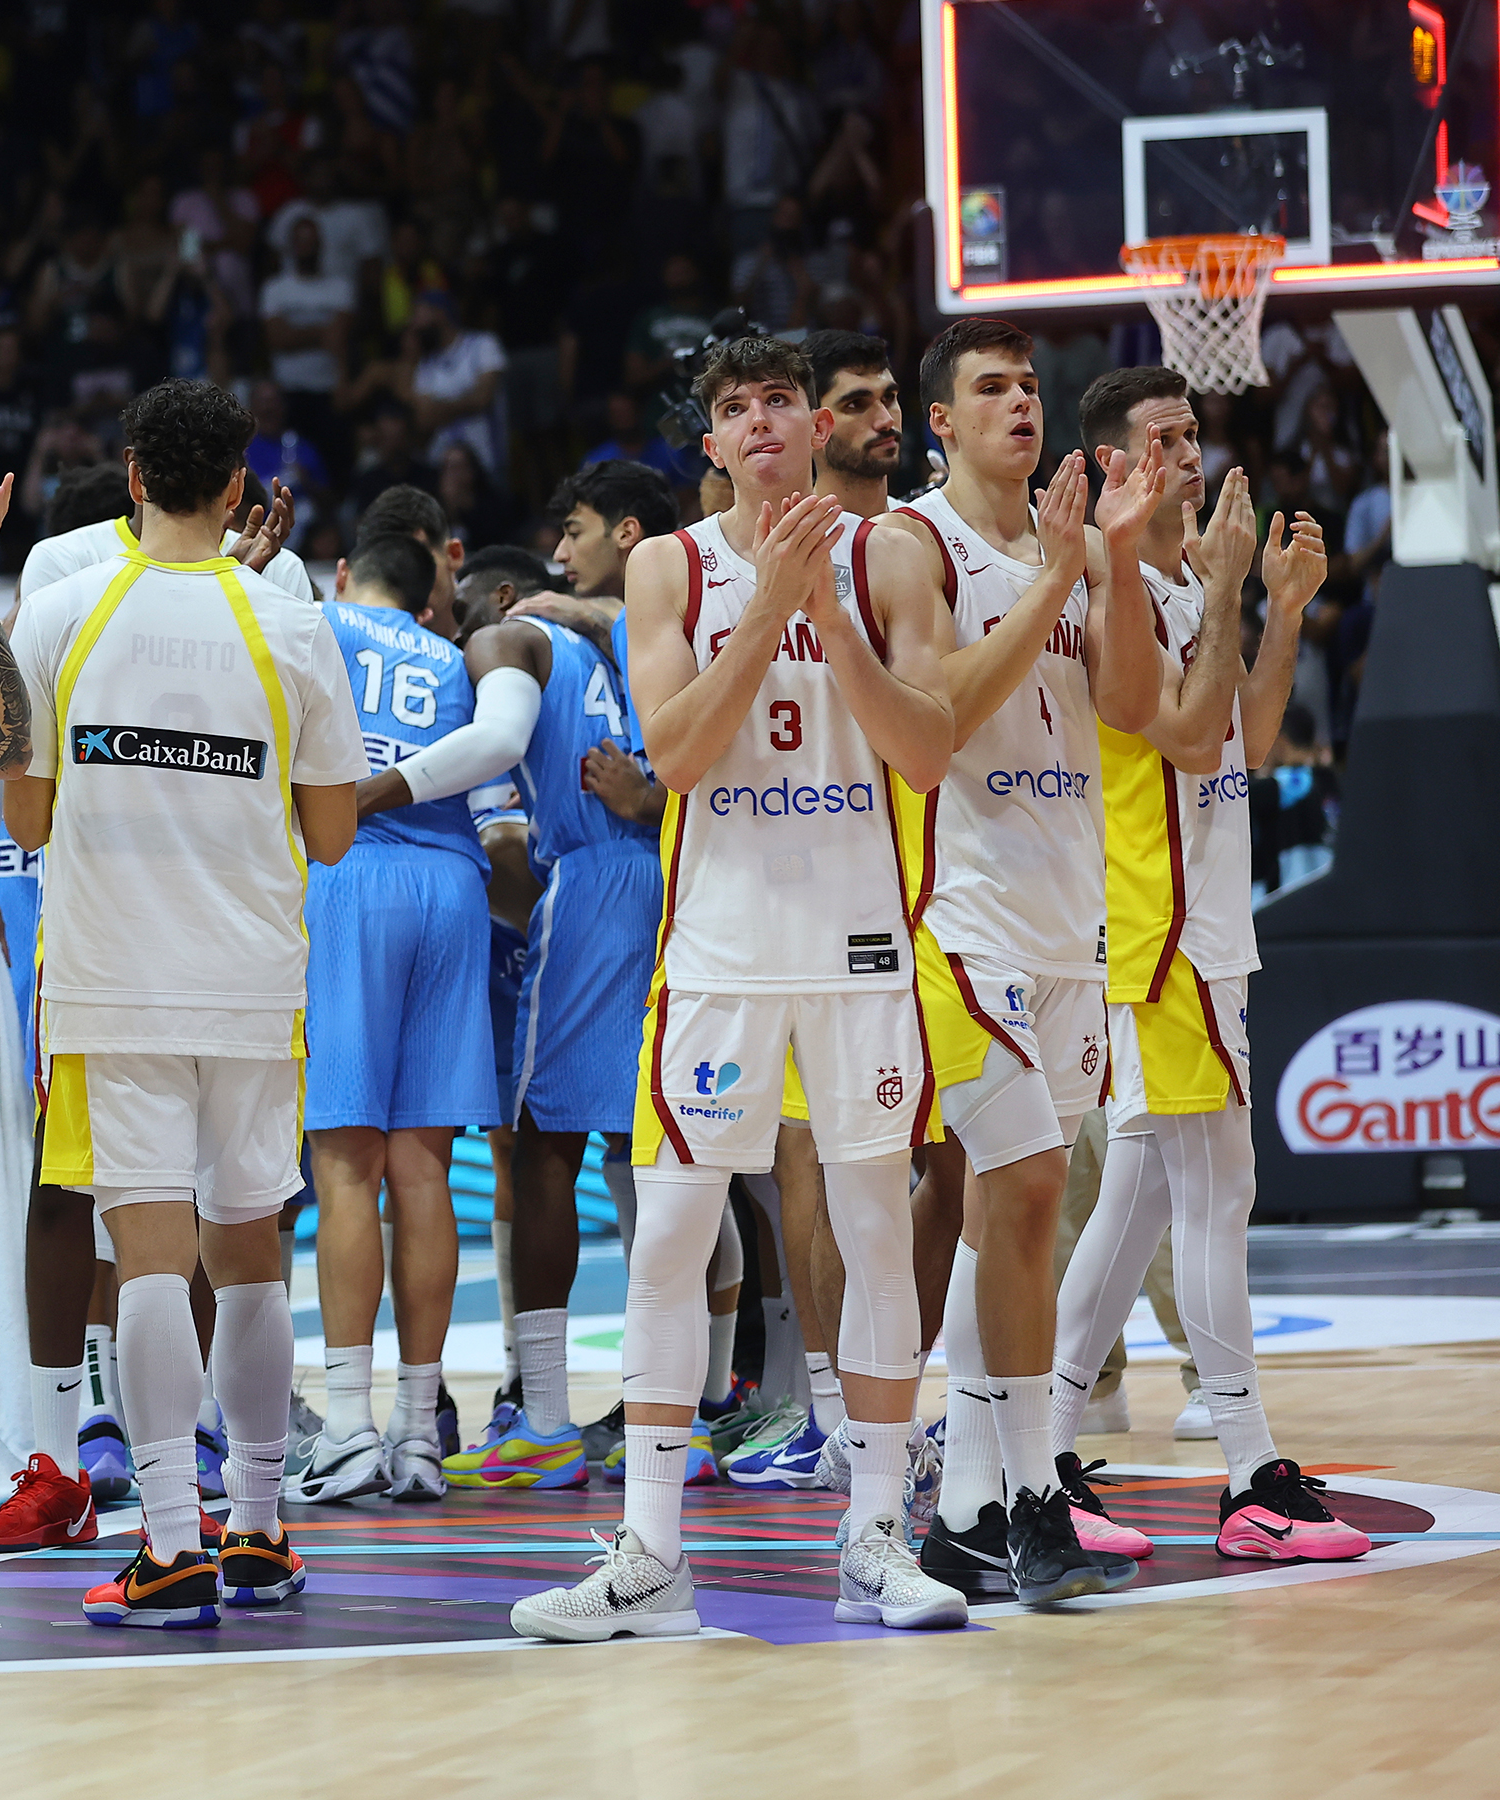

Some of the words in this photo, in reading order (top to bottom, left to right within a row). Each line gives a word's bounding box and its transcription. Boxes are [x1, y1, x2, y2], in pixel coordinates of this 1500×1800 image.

[130, 633, 236, 673] PUERTO
[355, 647, 441, 730] 16
[769, 700, 803, 752] 3
[112, 731, 257, 775] CaixaBank
[709, 777, 874, 817] endesa
[879, 956, 891, 966] 48
[238, 1537, 251, 1548] 12
